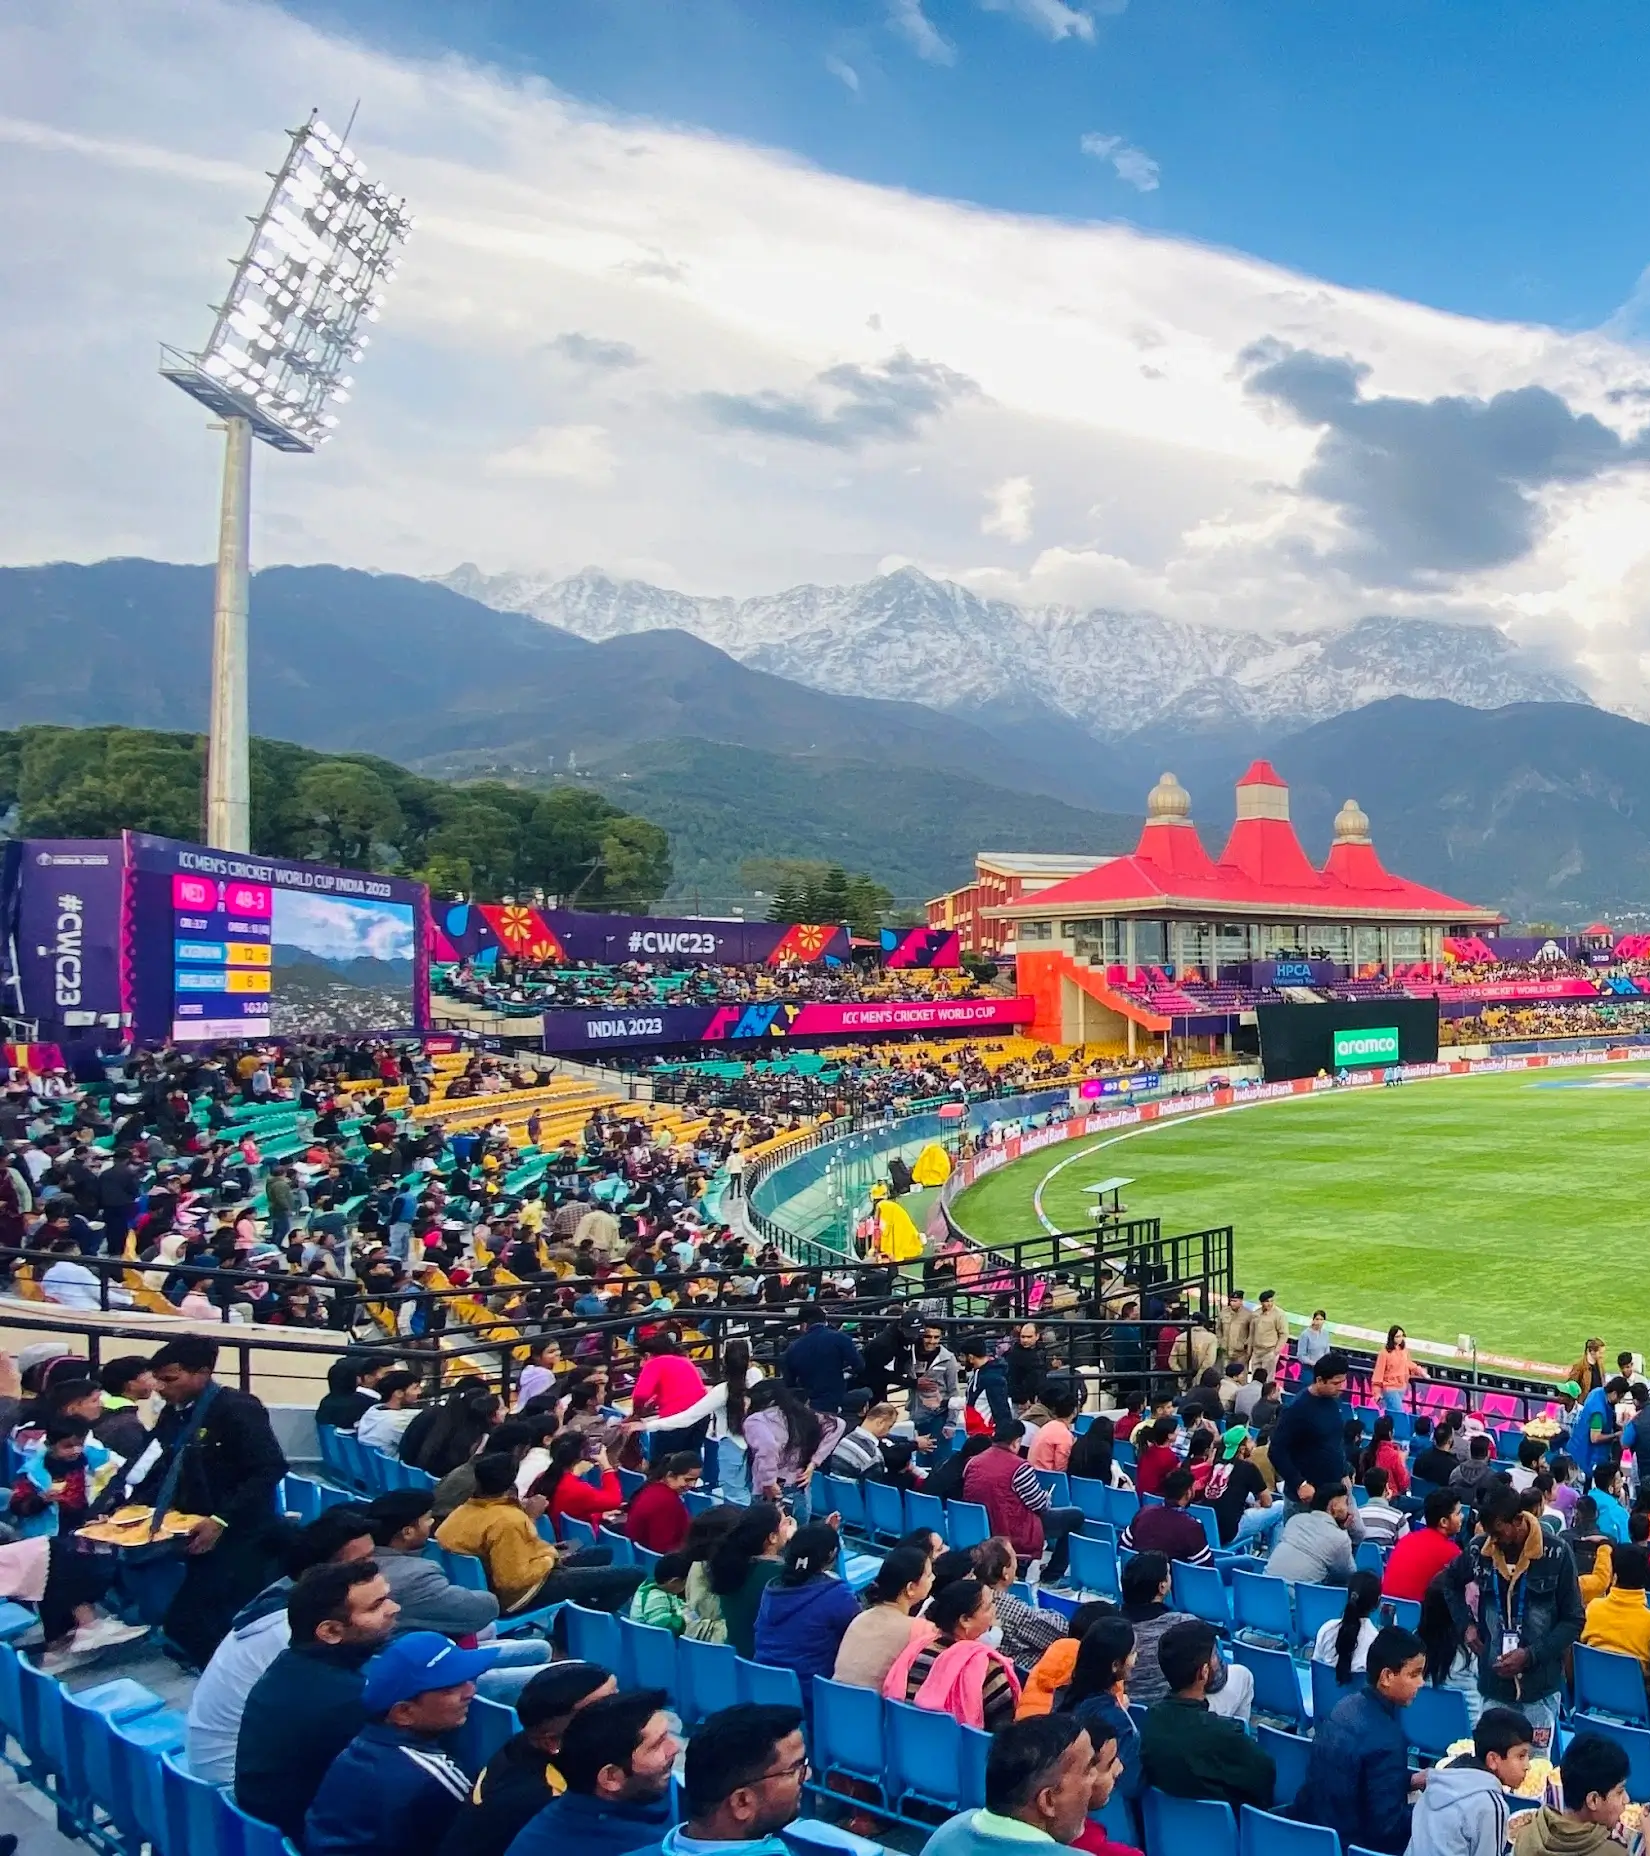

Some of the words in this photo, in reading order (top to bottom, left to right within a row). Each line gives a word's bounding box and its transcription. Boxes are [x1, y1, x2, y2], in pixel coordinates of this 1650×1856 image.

[179, 851, 194, 867] ICC
[195, 854, 227, 875] MEN'S
[228, 860, 273, 882] CRICKET
[276, 869, 313, 887] WORLD
[314, 875, 335, 889] CUP
[335, 878, 365, 894] INDIA
[366, 882, 391, 898] 2023
[181, 882, 206, 903] NED
[55, 894, 84, 1006] #CWC23
[628, 931, 717, 954] #CWC23
[1276, 964, 1312, 977] HPCA
[1481, 986, 1515, 996] CRICKET
[1516, 985, 1545, 995] WORLD
[1546, 984, 1563, 994] CUP
[841, 1012, 860, 1025] ICC
[860, 1011, 892, 1024] MEN'S
[894, 1008, 936, 1022] CRICKET
[938, 1007, 974, 1021] WORLD
[975, 1006, 996, 1019] CUP
[587, 1019, 627, 1039] INDIA
[628, 1018, 663, 1036] 2023
[1337, 1036, 1396, 1056] aramco
[1469, 1059, 1506, 1072] IndusInd
[1507, 1057, 1529, 1069] Bank
[1548, 1053, 1585, 1066] IndusInd
[1586, 1051, 1609, 1064] Bank
